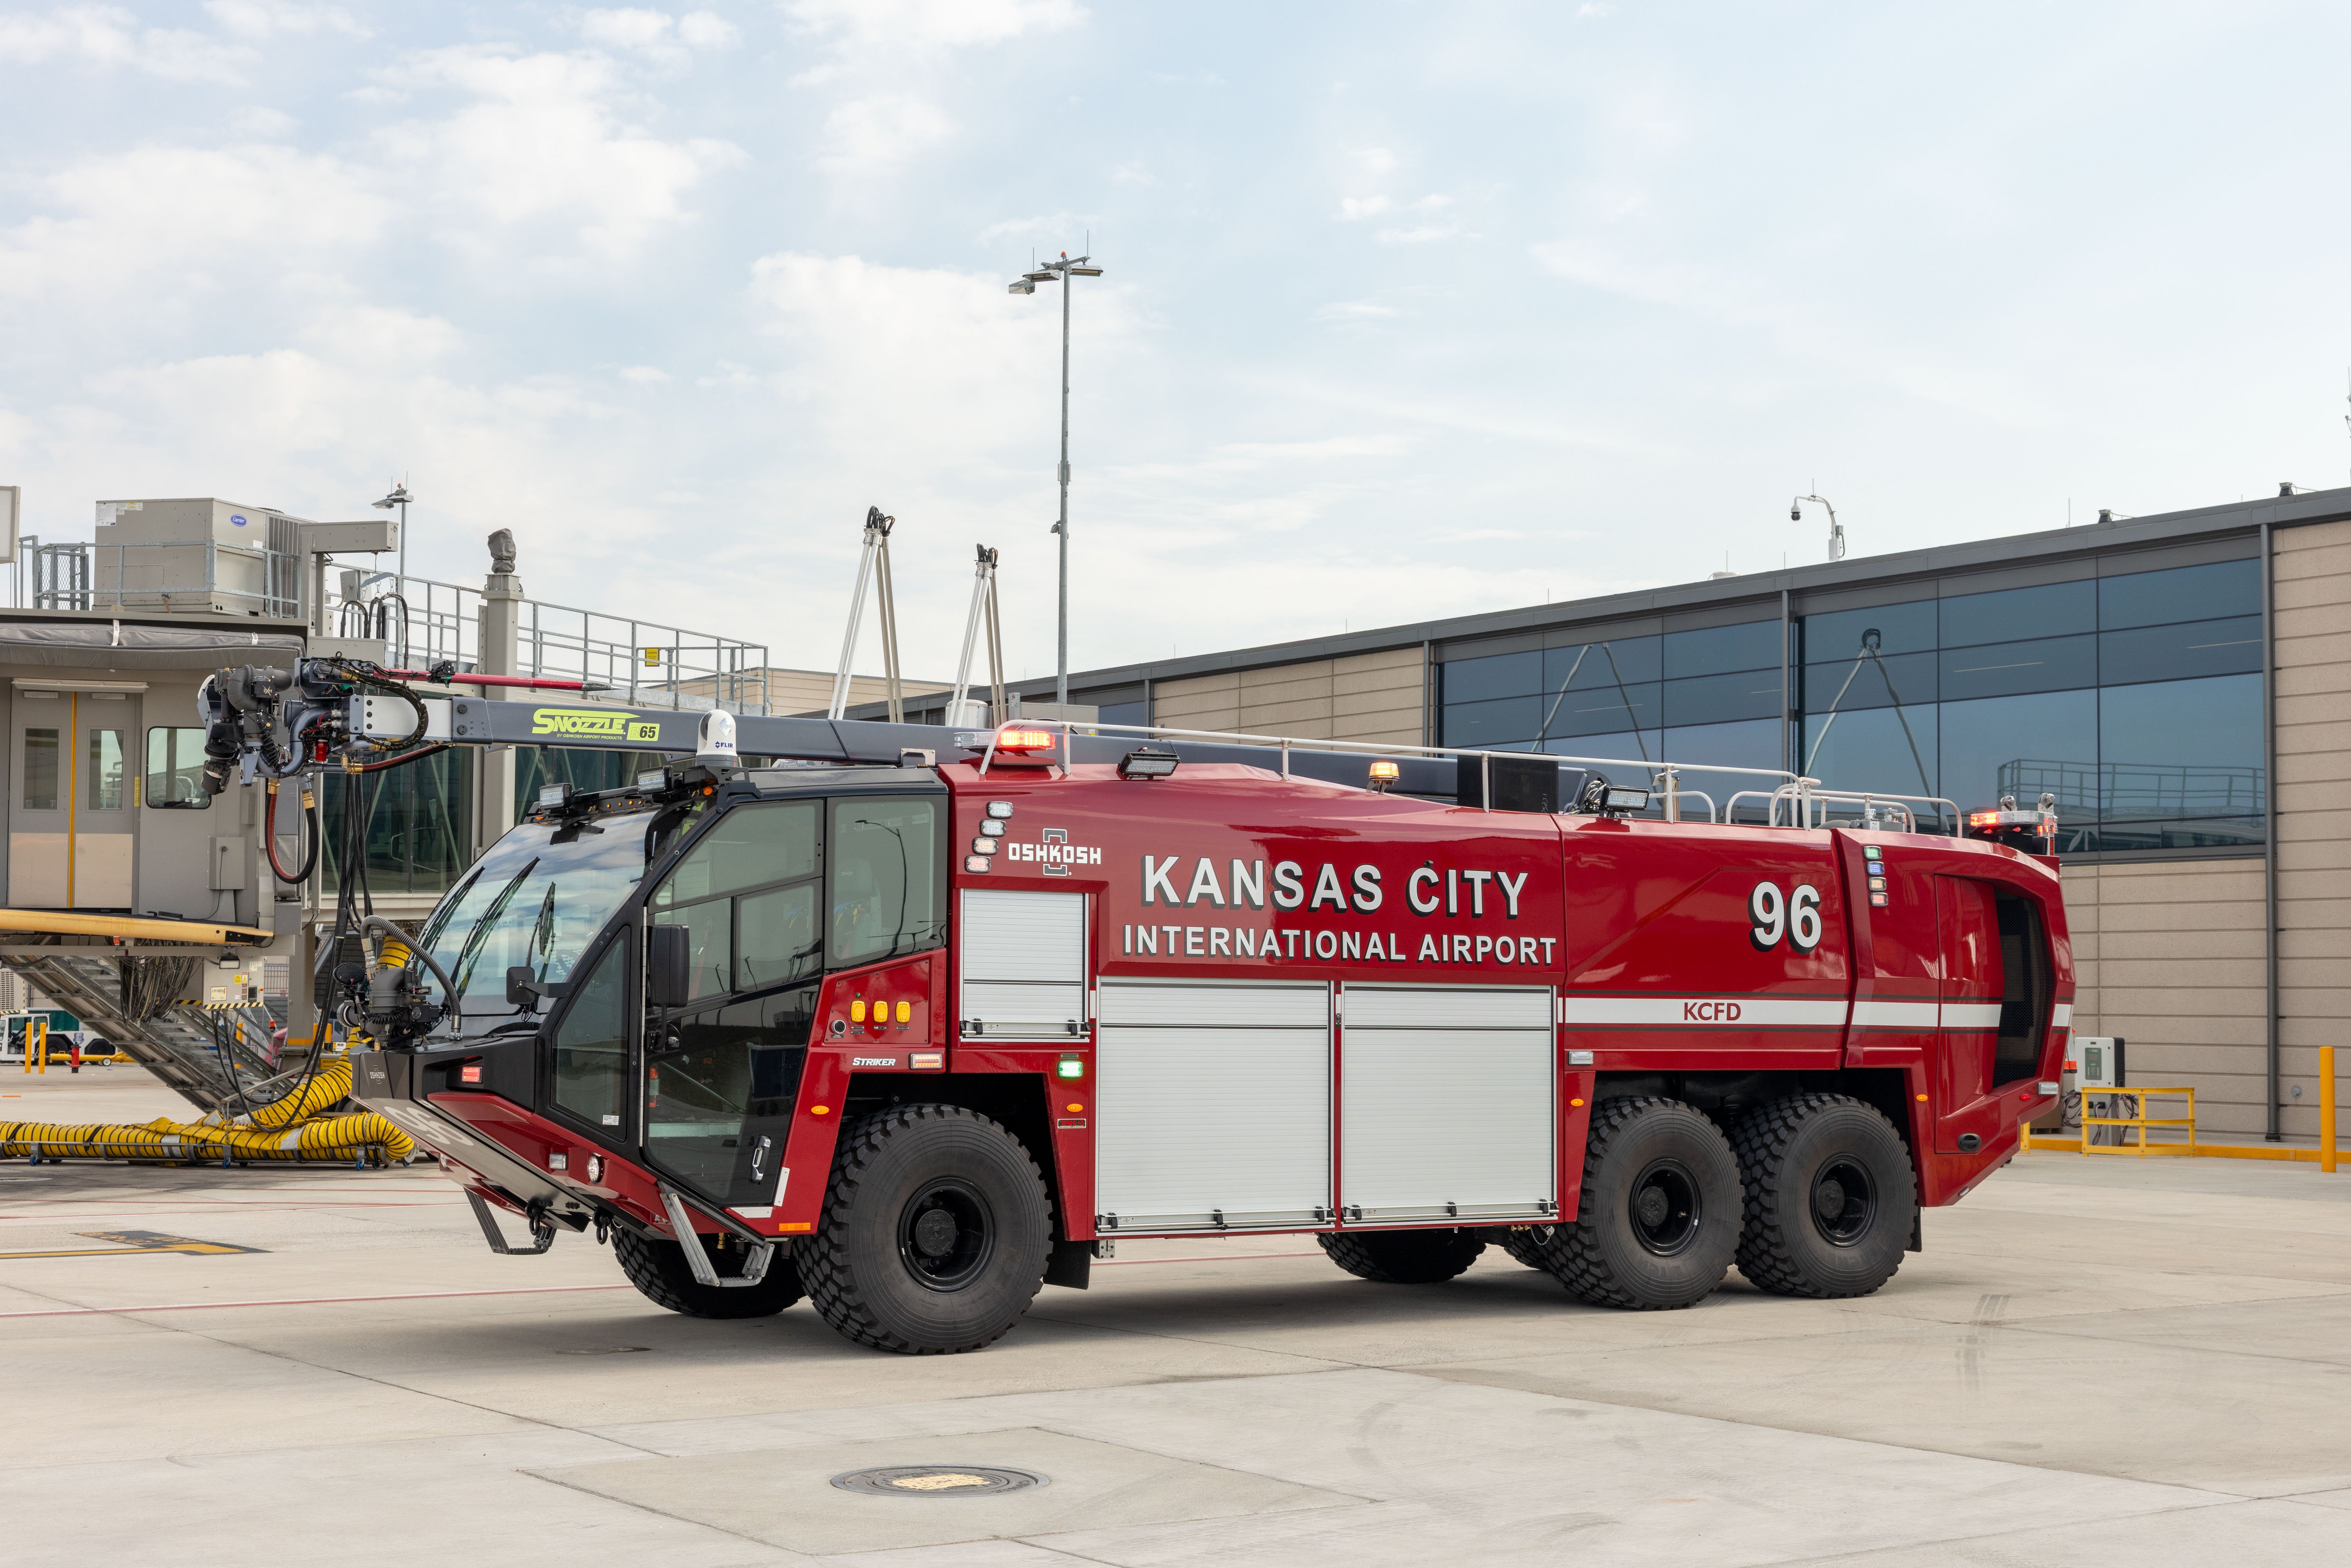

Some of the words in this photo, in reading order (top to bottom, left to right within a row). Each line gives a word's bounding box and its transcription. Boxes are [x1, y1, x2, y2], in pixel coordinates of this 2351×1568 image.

[532, 708, 641, 735] SNOZZLE
[1008, 843, 1101, 864] OSHKOSH
[1141, 855, 1383, 915] KANSAS
[1406, 867, 1529, 920] CITY
[1748, 881, 1822, 955] 96
[1123, 924, 1406, 962] INTERNATIONAL
[1417, 933, 1557, 966] AIRPORT
[1684, 1002, 1742, 1021] KCFD
[852, 1057, 896, 1066] STRIKER
[384, 1106, 474, 1146] 96
